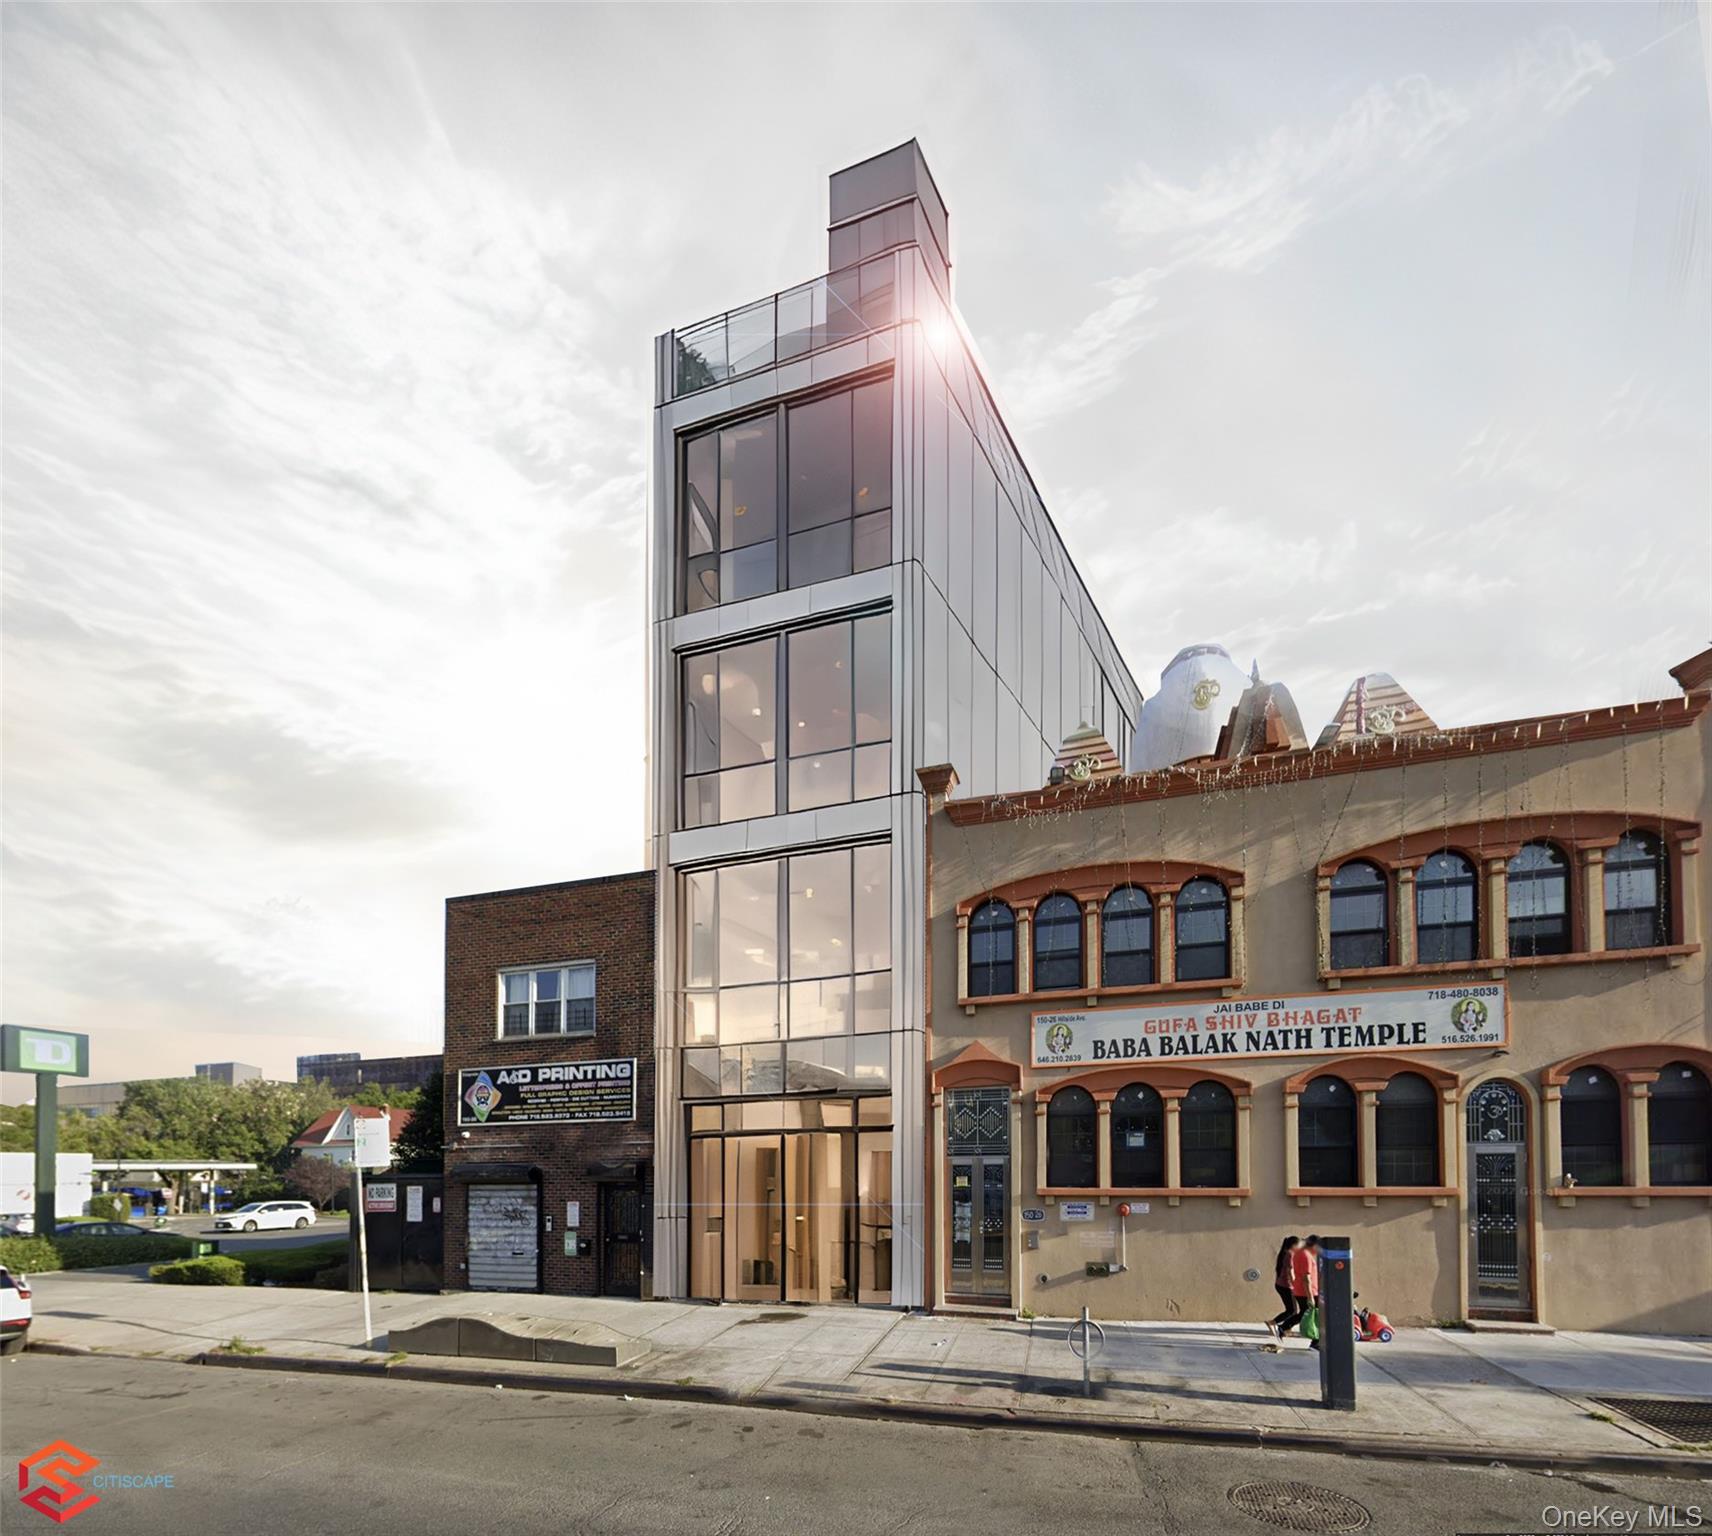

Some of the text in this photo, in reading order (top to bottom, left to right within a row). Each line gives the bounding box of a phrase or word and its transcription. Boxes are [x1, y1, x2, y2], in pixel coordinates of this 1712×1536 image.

[1428, 987, 1499, 1000] 718-480-8038
[1213, 1000, 1284, 1014] JAI BABE DI
[1205, 1013, 1257, 1031] SHIV
[1267, 1007, 1361, 1027] BHAGAT
[1092, 1022, 1427, 1059] BABA BALAK NATH TEMPLE
[1441, 1033, 1499, 1044] 516.526.1991
[25, 1038, 71, 1065] TD
[538, 1063, 631, 1082] PRINTING
